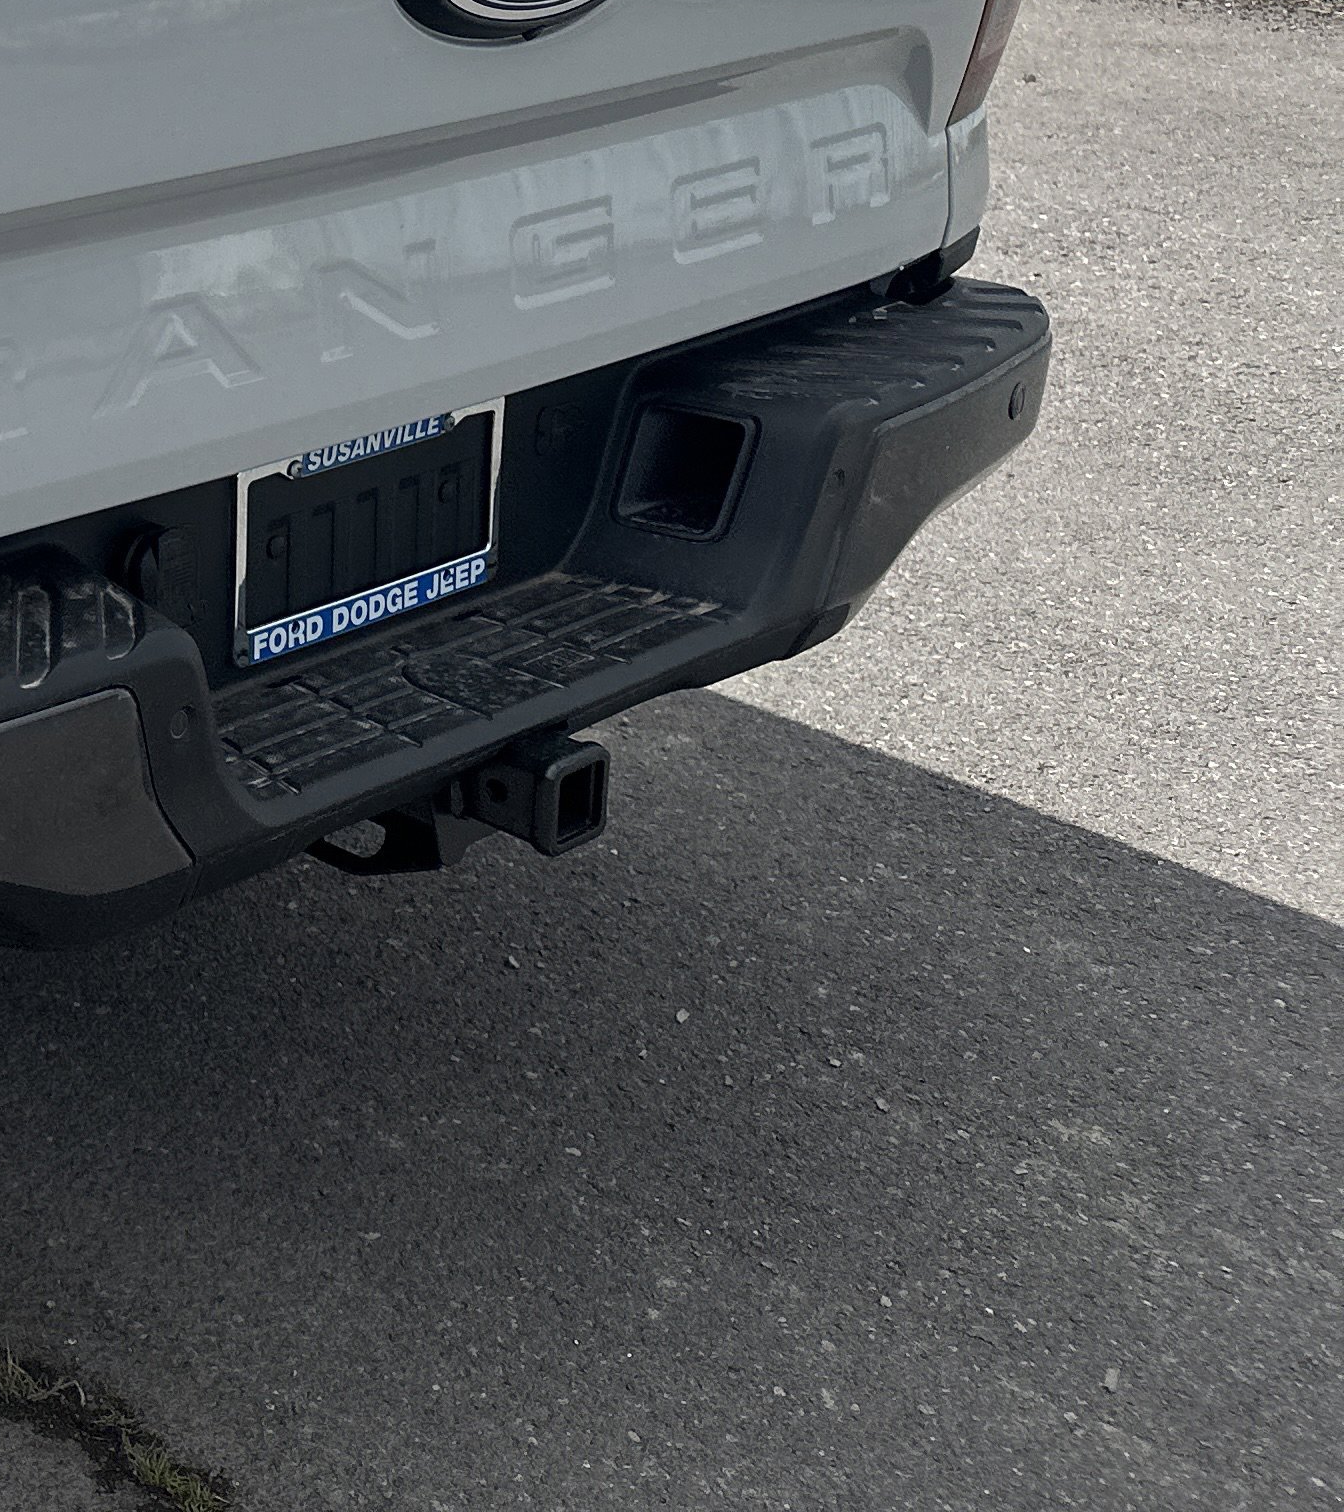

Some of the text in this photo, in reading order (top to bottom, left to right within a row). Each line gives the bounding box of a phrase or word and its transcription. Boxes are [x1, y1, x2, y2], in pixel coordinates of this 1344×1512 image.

[307, 416, 441, 472] SUSANVILLE
[253, 558, 486, 661] FORD DODGE JEEP
